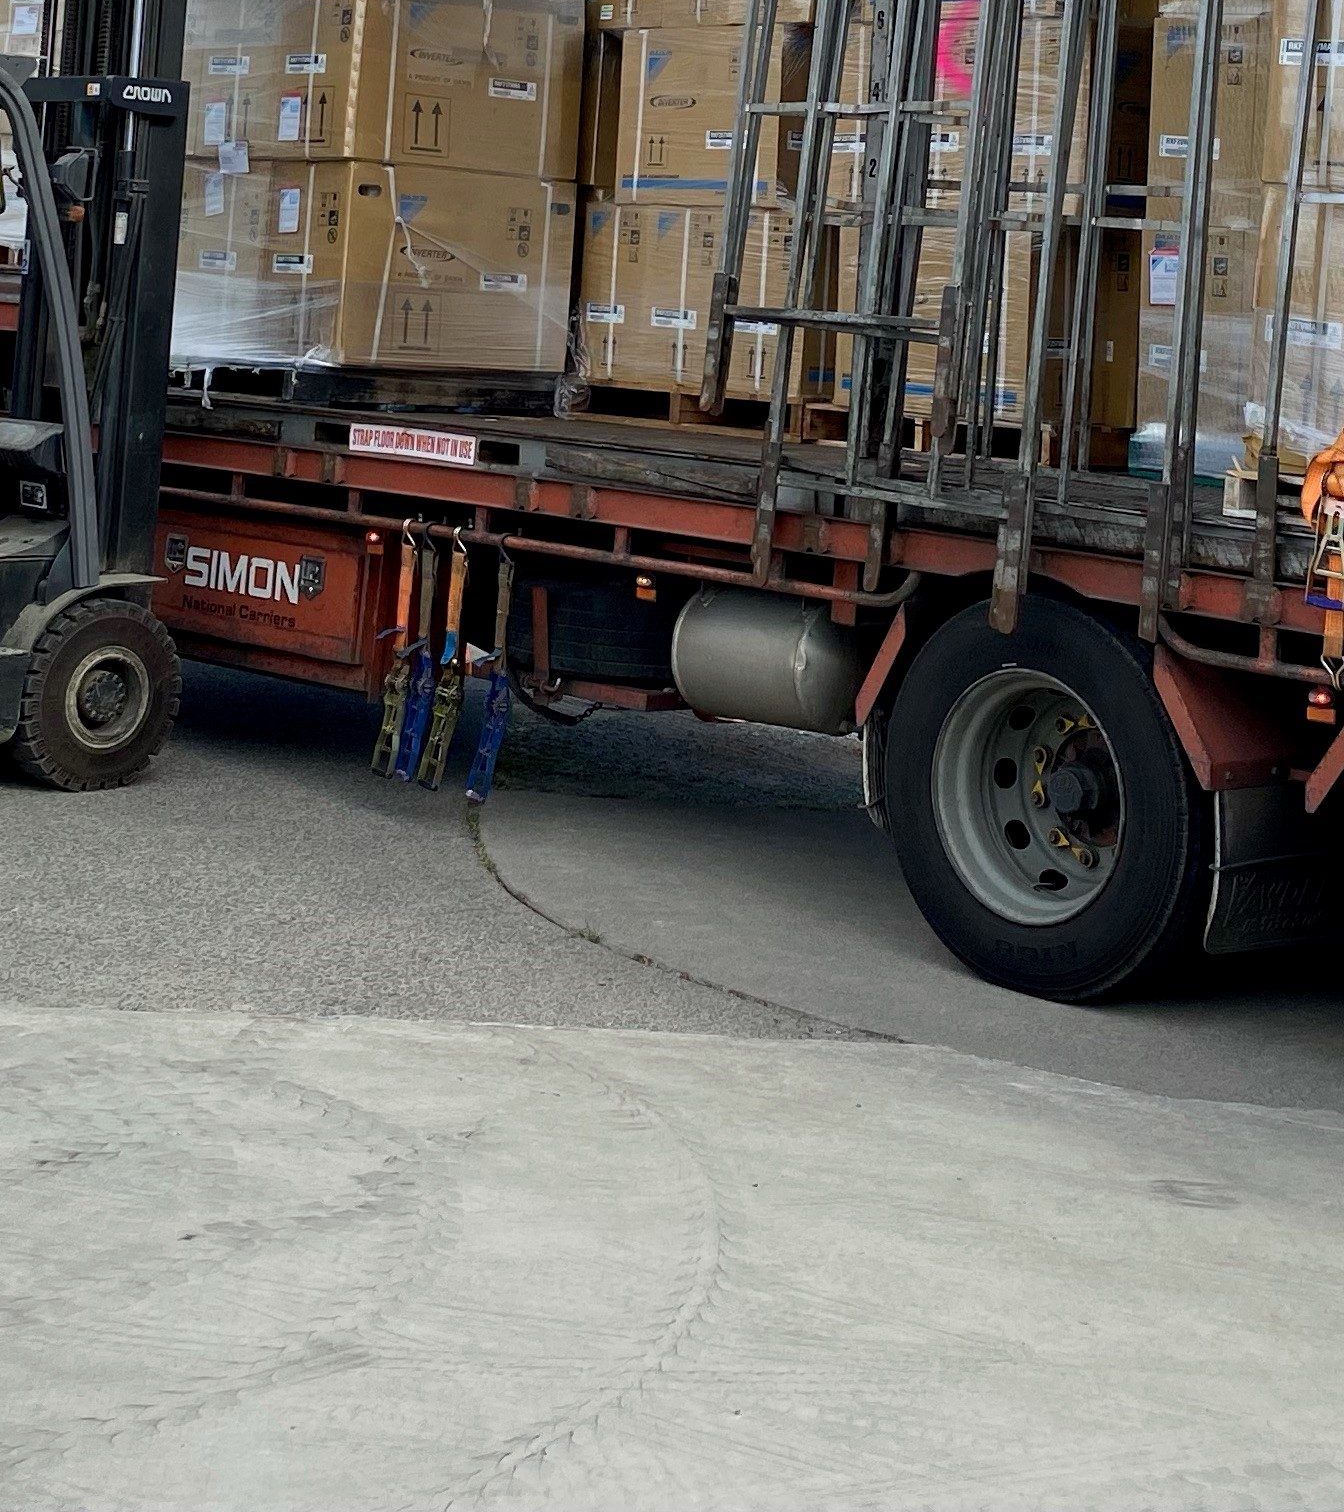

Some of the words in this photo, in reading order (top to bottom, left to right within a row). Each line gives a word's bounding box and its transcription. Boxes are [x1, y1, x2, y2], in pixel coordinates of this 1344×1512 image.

[872, 82, 880, 102] 4
[868, 158, 877, 178] 2
[352, 428, 374, 446] STRAP
[436, 437, 450, 455] NOT
[459, 441, 473, 459] USE
[184, 546, 301, 605] SIMON
[181, 594, 237, 618] National
[239, 605, 296, 629] Carriers
